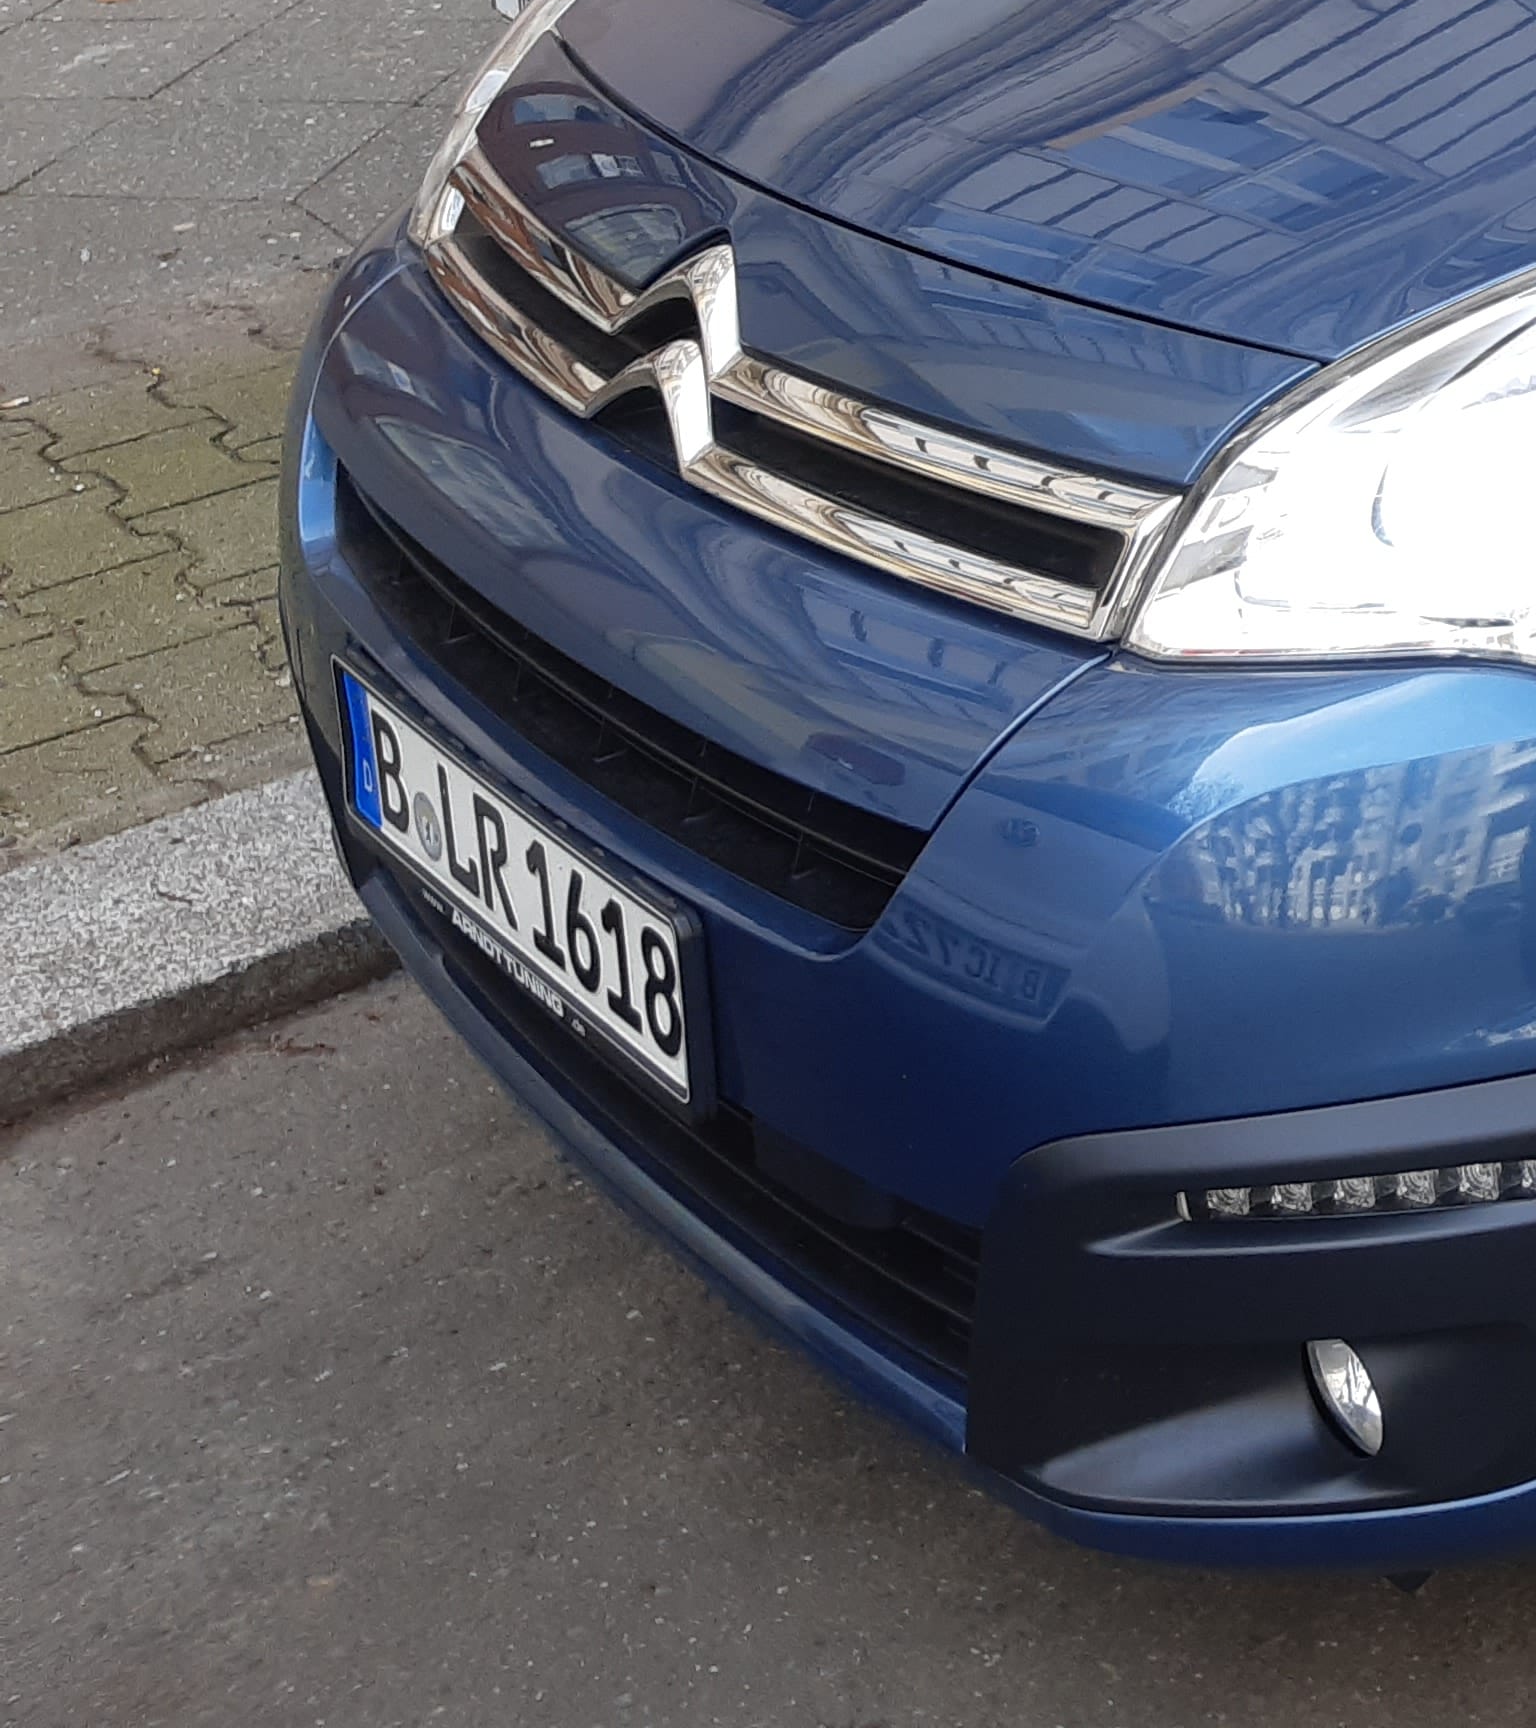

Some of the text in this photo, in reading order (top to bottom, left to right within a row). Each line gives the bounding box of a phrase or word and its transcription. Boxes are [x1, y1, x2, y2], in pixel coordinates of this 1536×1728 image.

[363, 759, 373, 792] D
[371, 708, 681, 1058] B LR 1618
[452, 910, 501, 965] ARNDT
[504, 955, 564, 1017] TUNING
